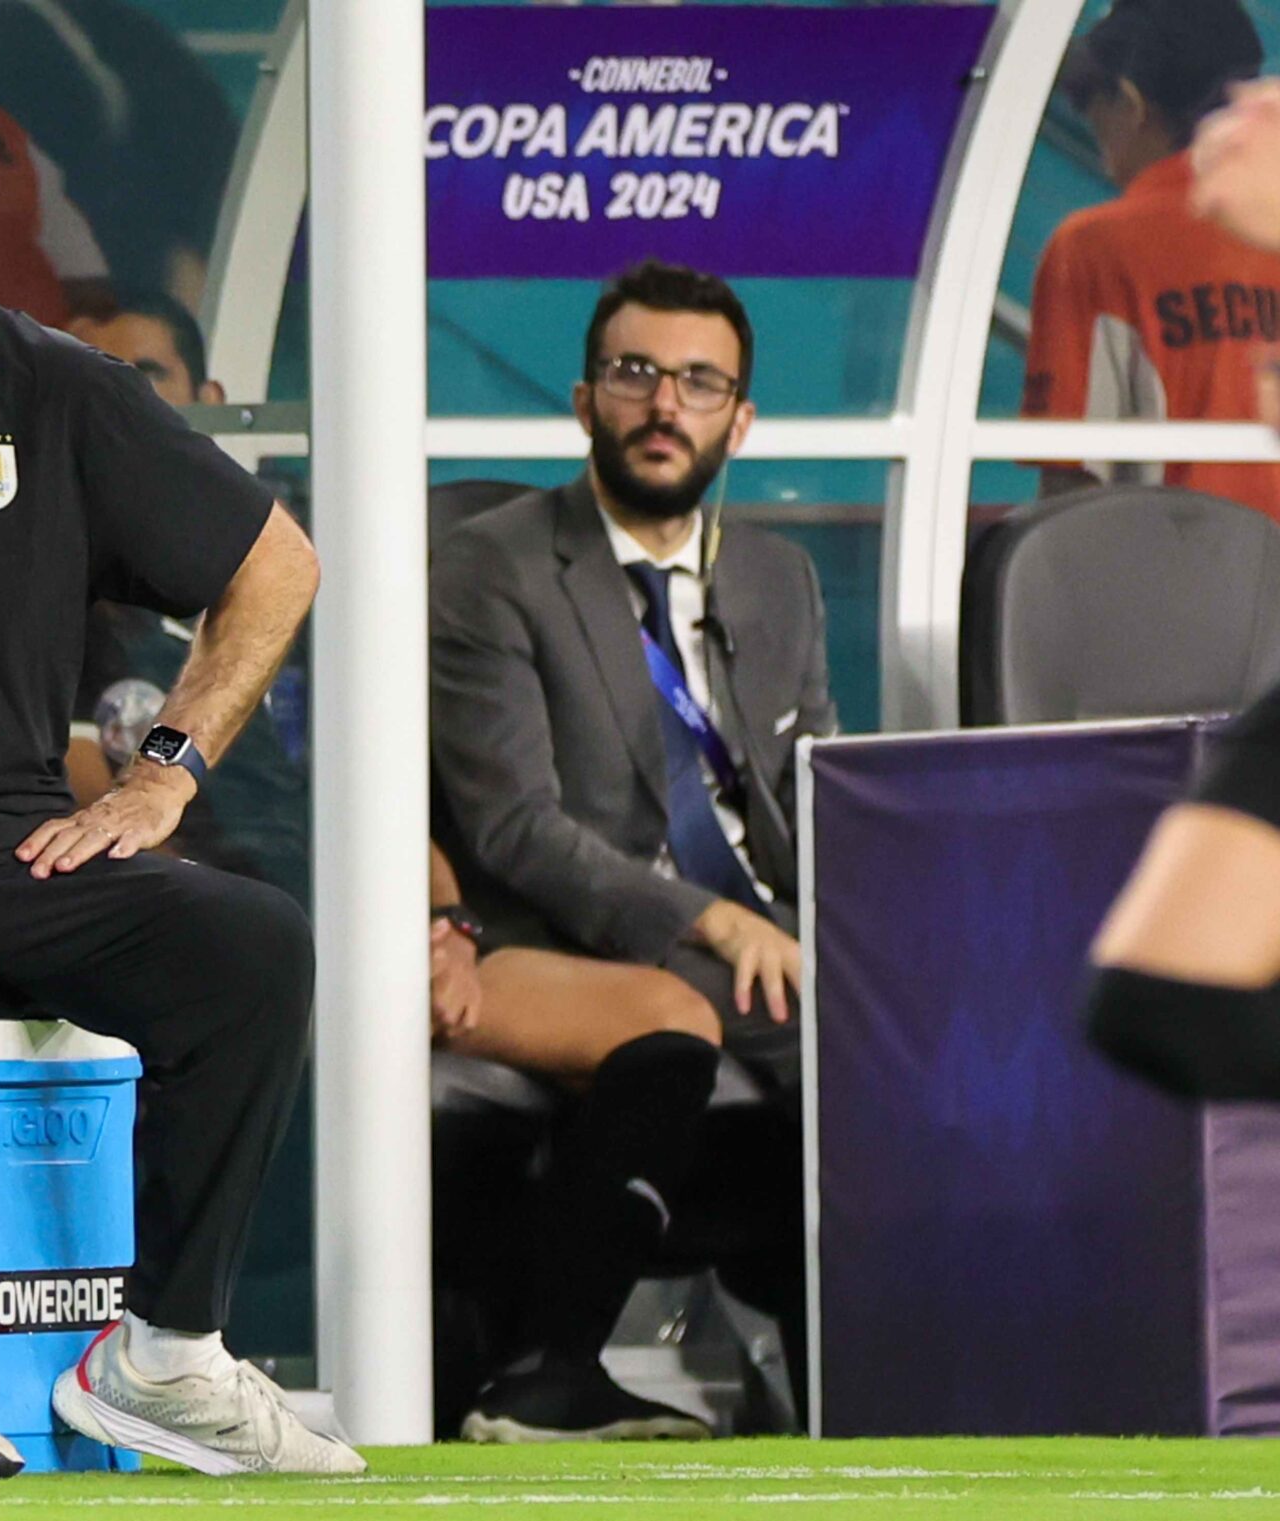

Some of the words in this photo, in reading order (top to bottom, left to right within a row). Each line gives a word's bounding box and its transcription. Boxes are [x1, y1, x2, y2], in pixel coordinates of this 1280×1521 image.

[580, 56, 714, 93] CONMEBOL
[424, 103, 567, 159] COPA
[574, 102, 839, 158] AMERICA
[502, 172, 589, 221] USA
[604, 171, 721, 220] 2024
[1154, 283, 1280, 348] SECU
